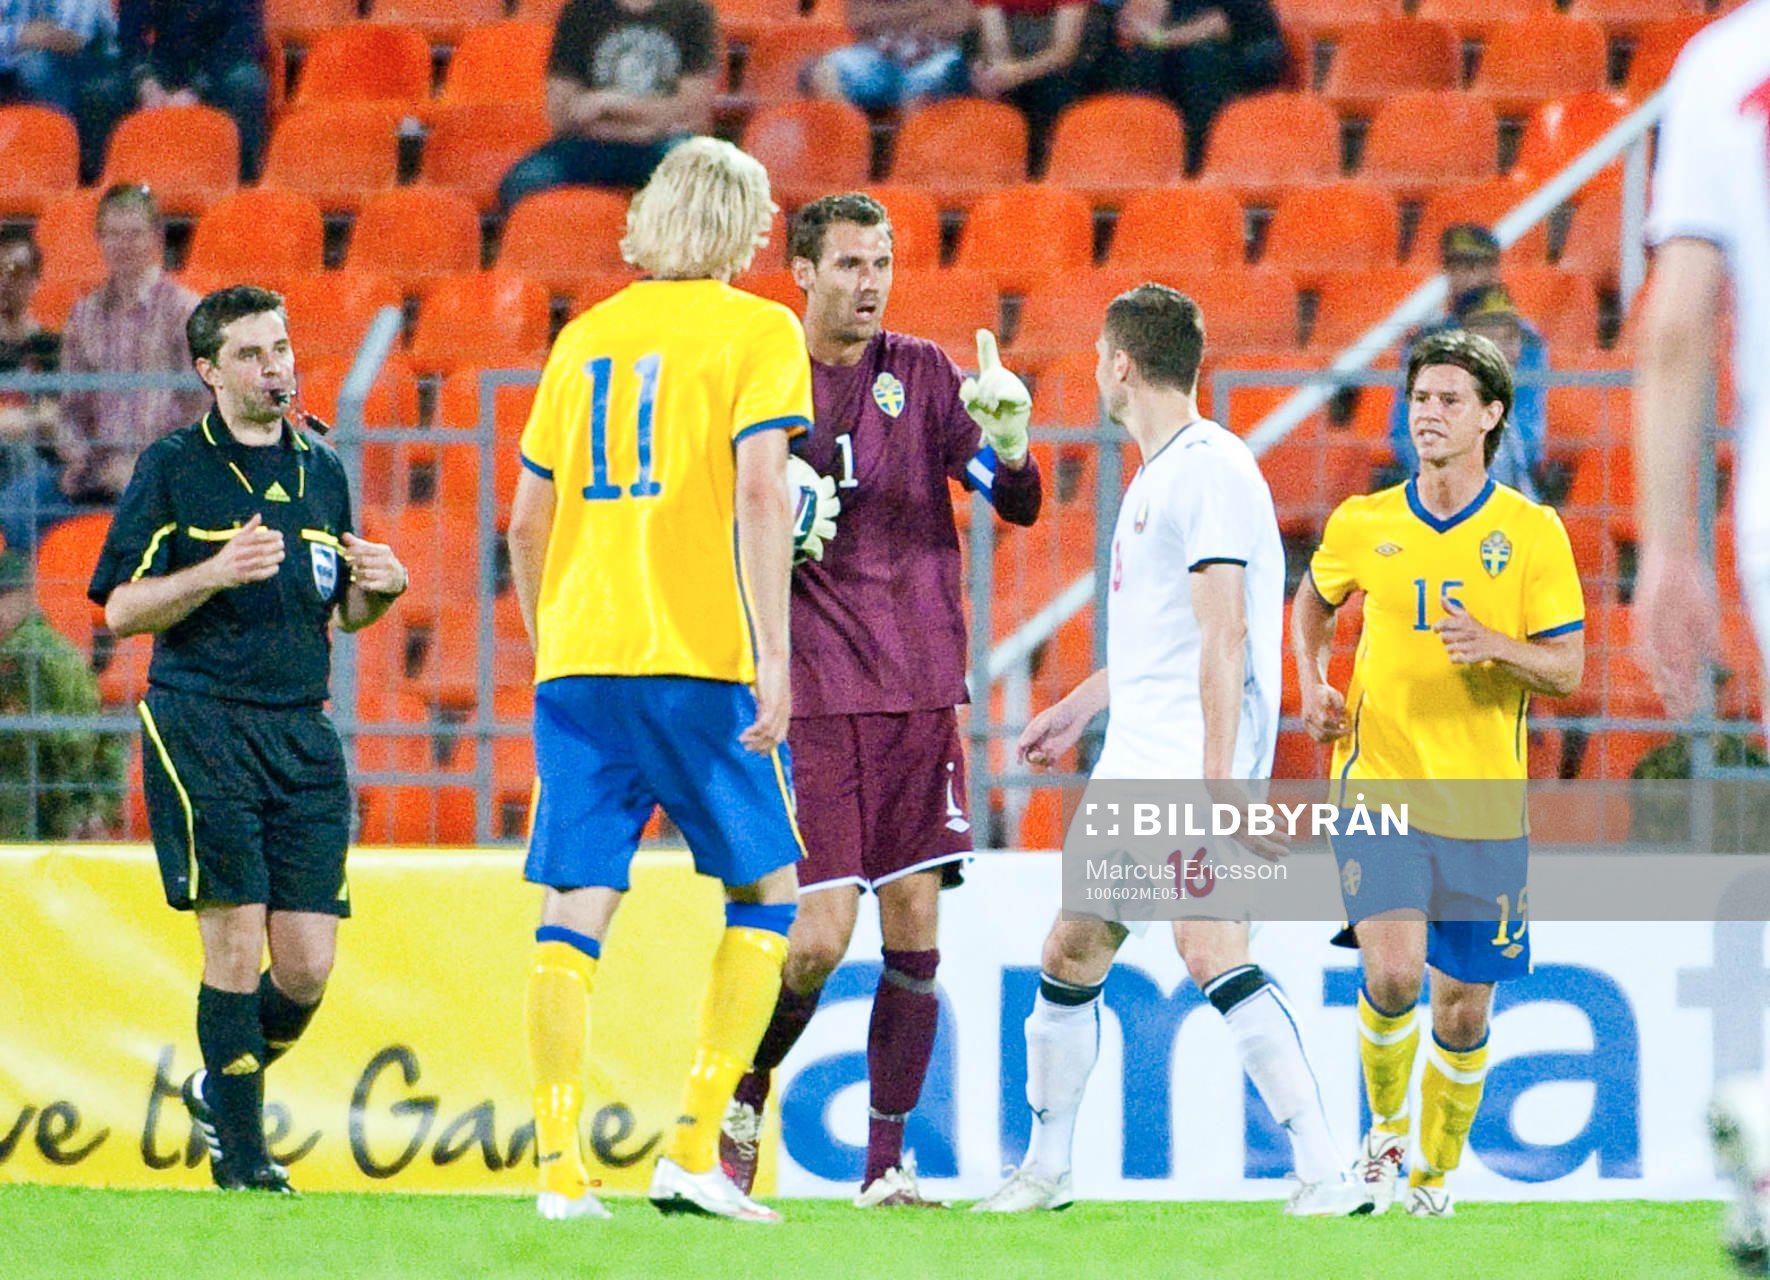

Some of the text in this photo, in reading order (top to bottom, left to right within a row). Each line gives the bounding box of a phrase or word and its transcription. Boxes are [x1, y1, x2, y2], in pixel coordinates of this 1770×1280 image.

[582, 353, 663, 499] 11
[835, 432, 859, 488] 1
[1167, 847, 1215, 899] 16
[141, 1045, 322, 1169] te
